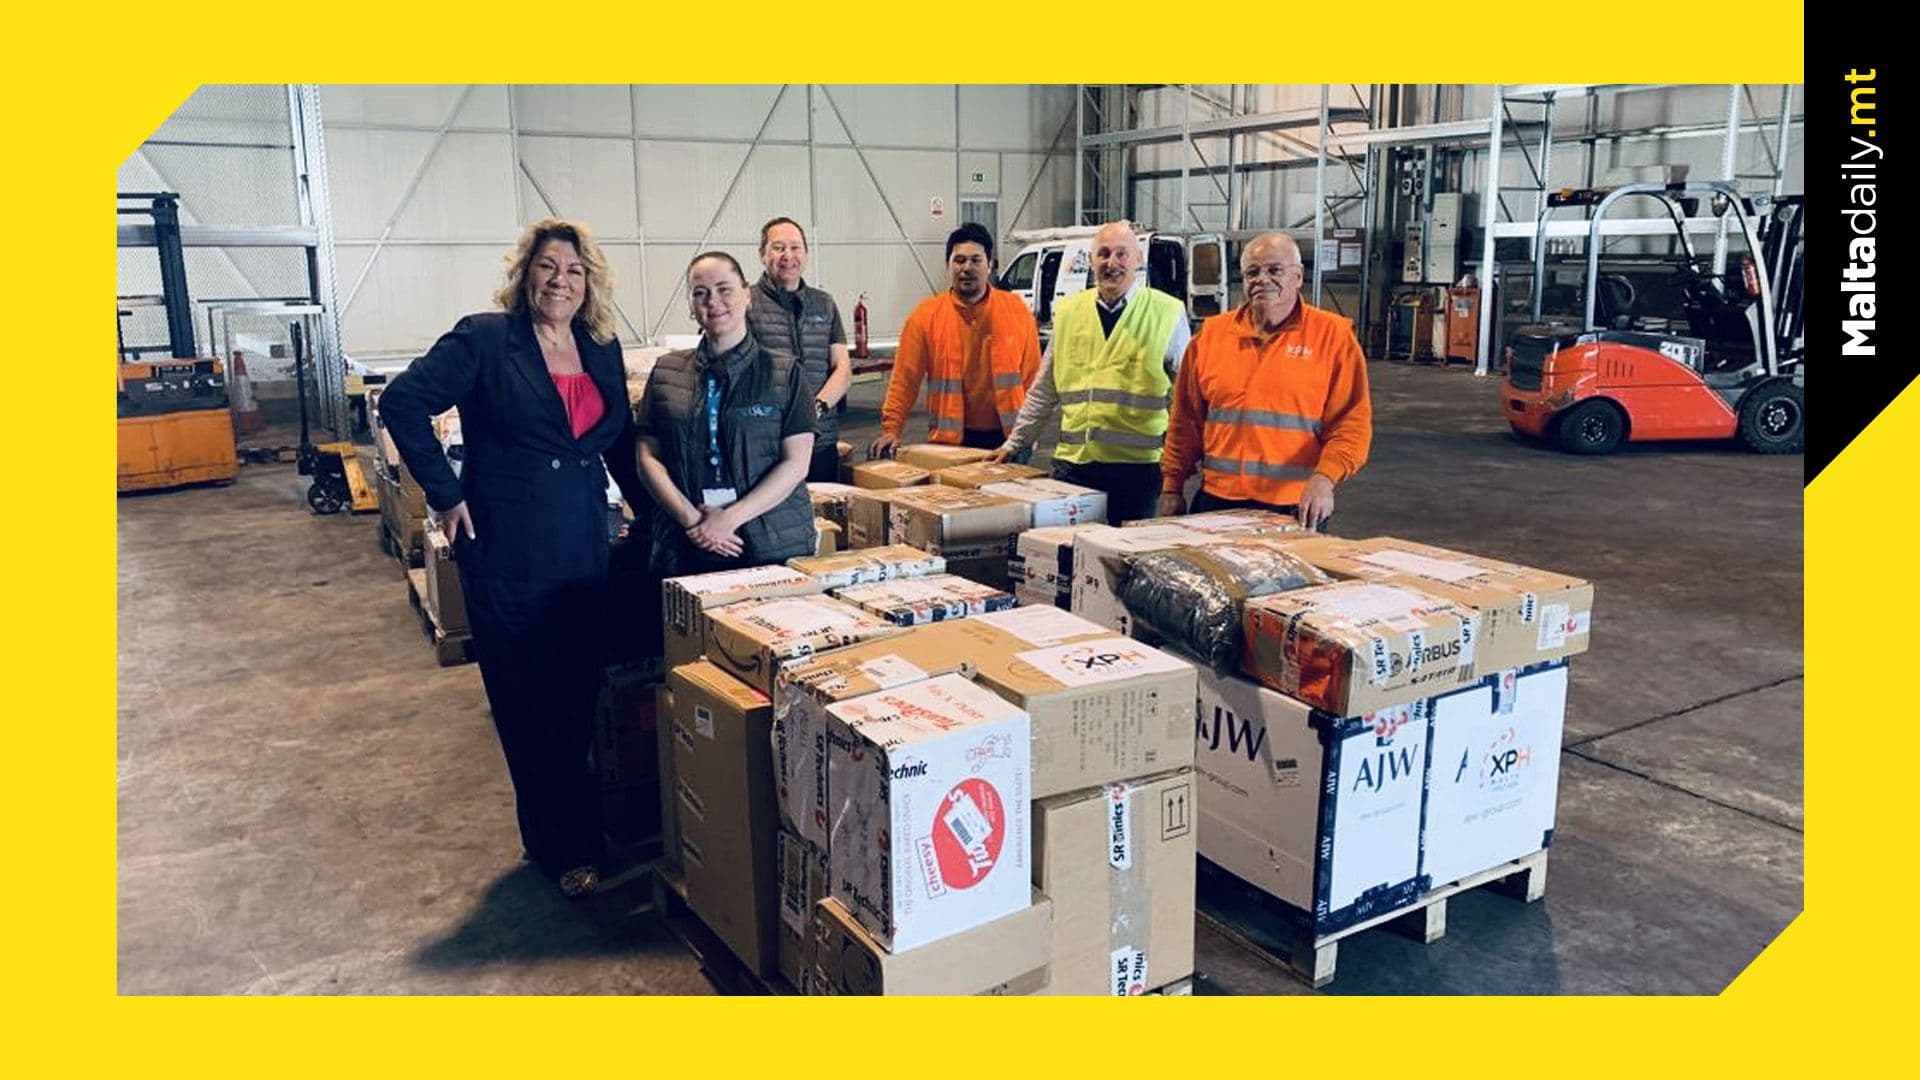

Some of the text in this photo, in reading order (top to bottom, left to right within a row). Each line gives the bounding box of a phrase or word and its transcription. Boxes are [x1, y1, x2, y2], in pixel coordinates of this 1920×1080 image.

[1073, 650, 1147, 669] XPH
[1405, 639, 1461, 669] RBUS
[1354, 743, 1418, 793] AJW
[1490, 742, 1530, 777] XPH
[1326, 770, 1337, 795] AJW
[1320, 835, 1332, 860] AJW
[922, 842, 942, 893] cheesy
[1118, 958, 1128, 974] SR
